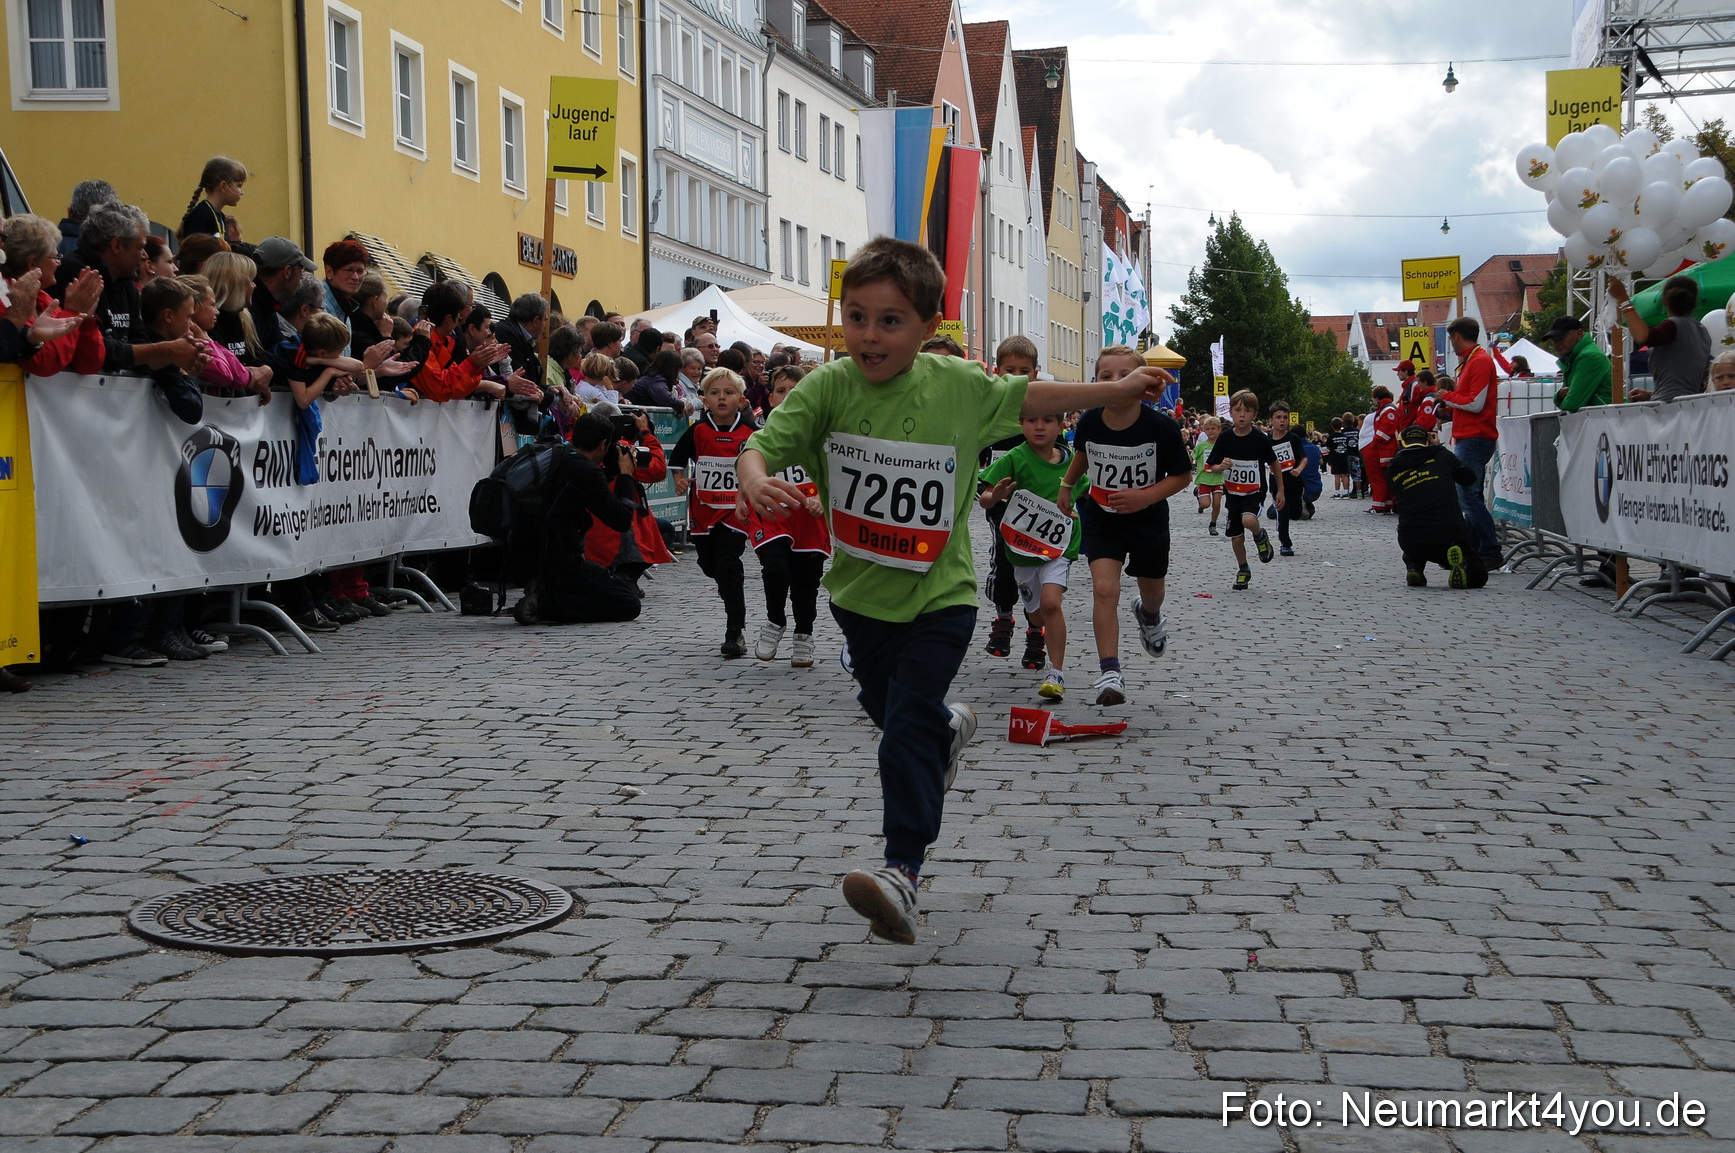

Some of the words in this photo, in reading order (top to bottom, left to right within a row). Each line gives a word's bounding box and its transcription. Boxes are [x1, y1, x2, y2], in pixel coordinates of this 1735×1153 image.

[552, 103, 615, 123] Jugend-
[1548, 96, 1618, 119] Jugend-
[568, 124, 599, 141] lauf
[1405, 269, 1456, 280] Schnupper-
[1422, 281, 1440, 290] lauf
[938, 321, 961, 331] Block
[1403, 329, 1429, 338] Block
[1408, 341, 1426, 363] A
[1217, 382, 1225, 392] B
[253, 439, 300, 489] BMW
[697, 460, 714, 468] PARTL
[830, 442, 870, 463] PARTL
[874, 452, 940, 471] Neumarkt
[1088, 448, 1108, 459] PARTL
[1109, 451, 1144, 461] Neumarkt
[1616, 444, 1644, 482] BMW
[1093, 461, 1149, 489] 7245
[1227, 468, 1256, 483] 7390
[711, 493, 736, 503] Julius
[841, 465, 944, 527] 7269
[1014, 491, 1035, 508] PARTL
[1036, 503, 1065, 522] Neumarkt
[253, 502, 309, 541] Weniger
[357, 492, 381, 523] Mehr
[382, 488, 441, 519] Fahrfreude.
[1618, 493, 1645, 524] Weniger
[1012, 503, 1066, 545] 7148
[858, 524, 917, 555] Daniel
[1012, 533, 1044, 554] Tobias
[1011, 718, 1038, 734] Au
